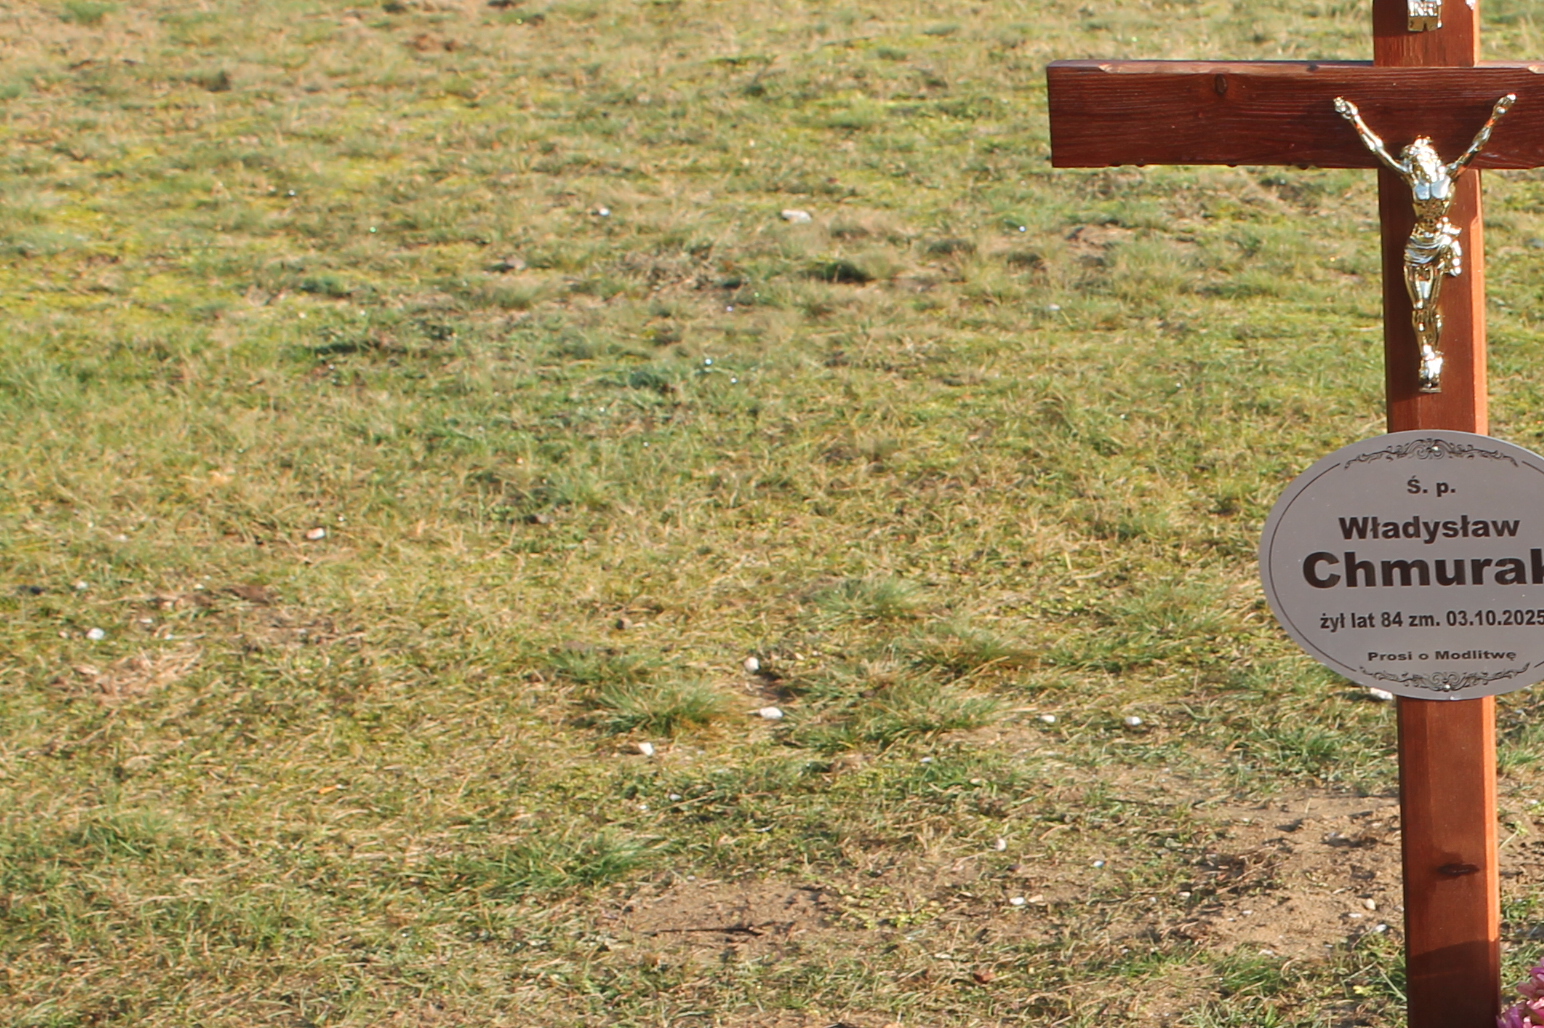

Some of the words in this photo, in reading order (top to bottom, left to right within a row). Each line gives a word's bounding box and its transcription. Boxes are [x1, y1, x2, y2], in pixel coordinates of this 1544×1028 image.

[1407, 475, 1428, 494] Ś.
[1436, 481, 1456, 497] p.
[1338, 514, 1521, 545] Władysław
[1320, 612, 1346, 633] żył
[1350, 612, 1375, 629] lat
[1381, 611, 1403, 628] 84
[1408, 614, 1440, 628] zm.
[1367, 651, 1413, 662] Prosi
[1418, 653, 1429, 661] o
[1435, 650, 1517, 662] Modlitwę
